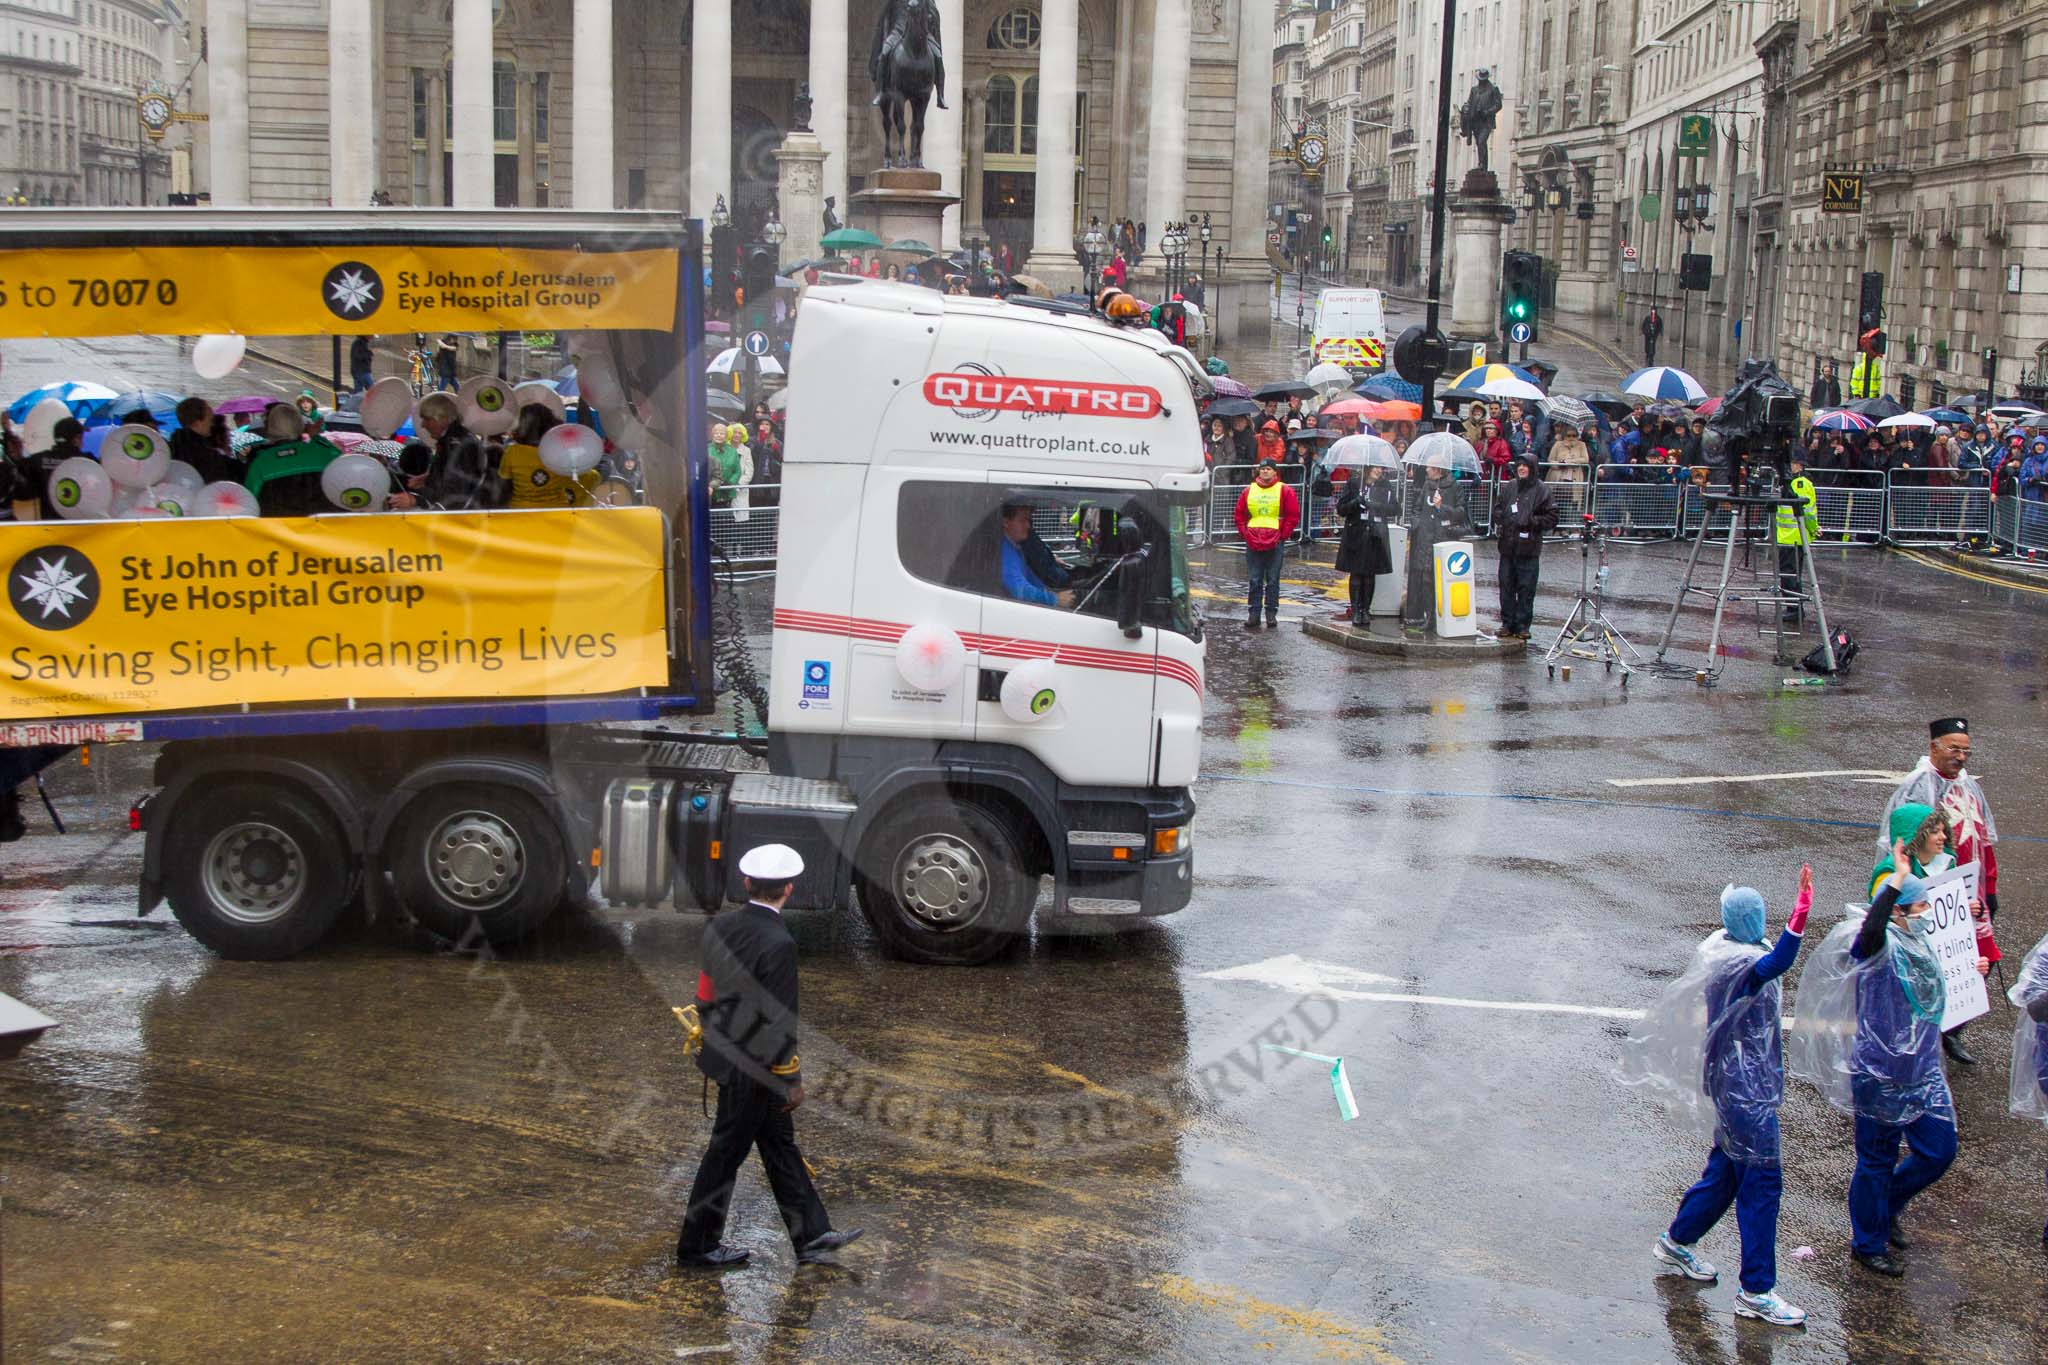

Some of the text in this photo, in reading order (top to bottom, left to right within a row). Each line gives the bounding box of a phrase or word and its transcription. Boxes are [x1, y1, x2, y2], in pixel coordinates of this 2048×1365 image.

[397, 270, 616, 289] St John of Jerusalem
[21, 281, 56, 307] to
[399, 289, 602, 314] Eye Hospital Group
[934, 376, 1152, 413] QUATTRO
[930, 430, 1151, 457] www.quattroplant.co.uk
[121, 548, 443, 581] St John of Jerusalem
[123, 580, 425, 618] Eye Hospital Group
[10, 626, 618, 685] Saving Sight, Changing Lives
[805, 684, 828, 694] FORS
[27, 722, 107, 746] POSITION
[1944, 932, 1973, 958] blind
